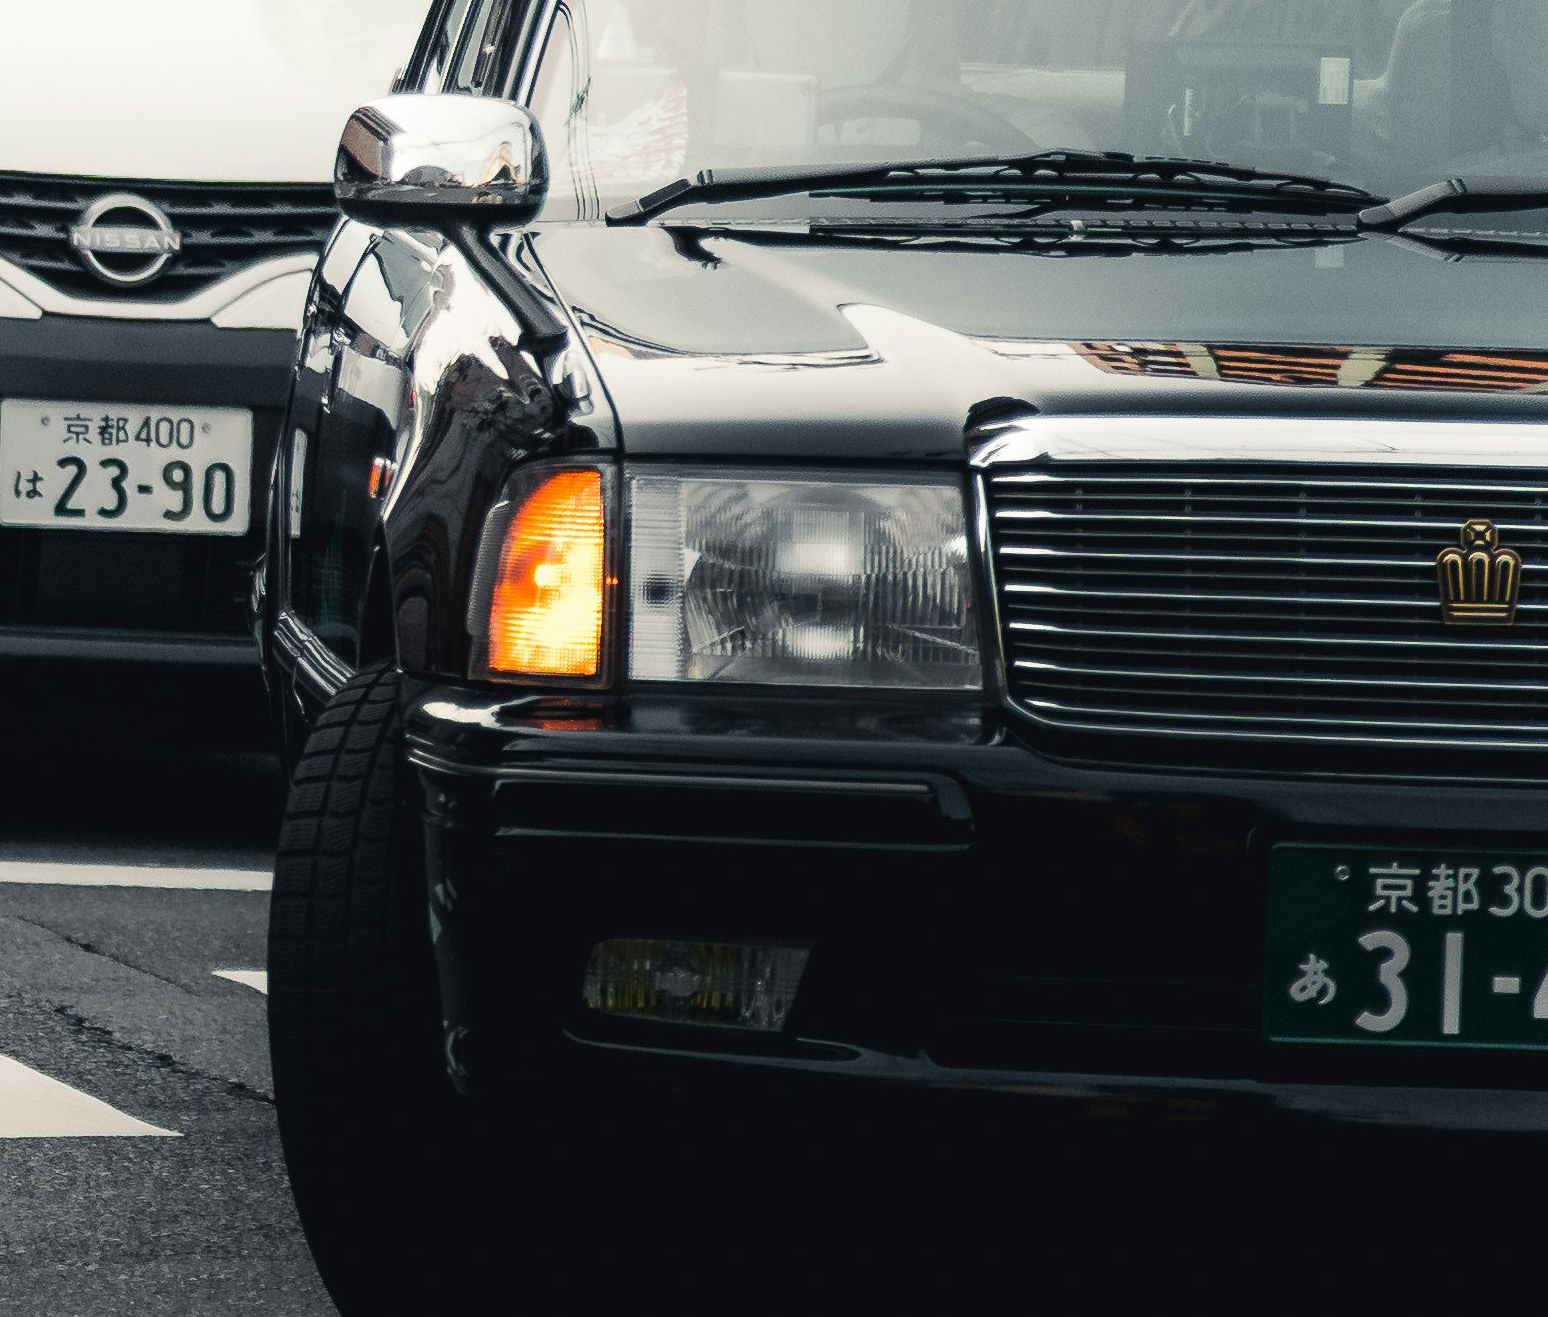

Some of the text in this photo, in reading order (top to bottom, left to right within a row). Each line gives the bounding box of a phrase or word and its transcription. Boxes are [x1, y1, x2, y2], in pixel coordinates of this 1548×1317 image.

[73, 232, 181, 251] NISSAN
[54, 455, 236, 523] 23-90
[1288, 930, 1548, 1035] あ 31-
